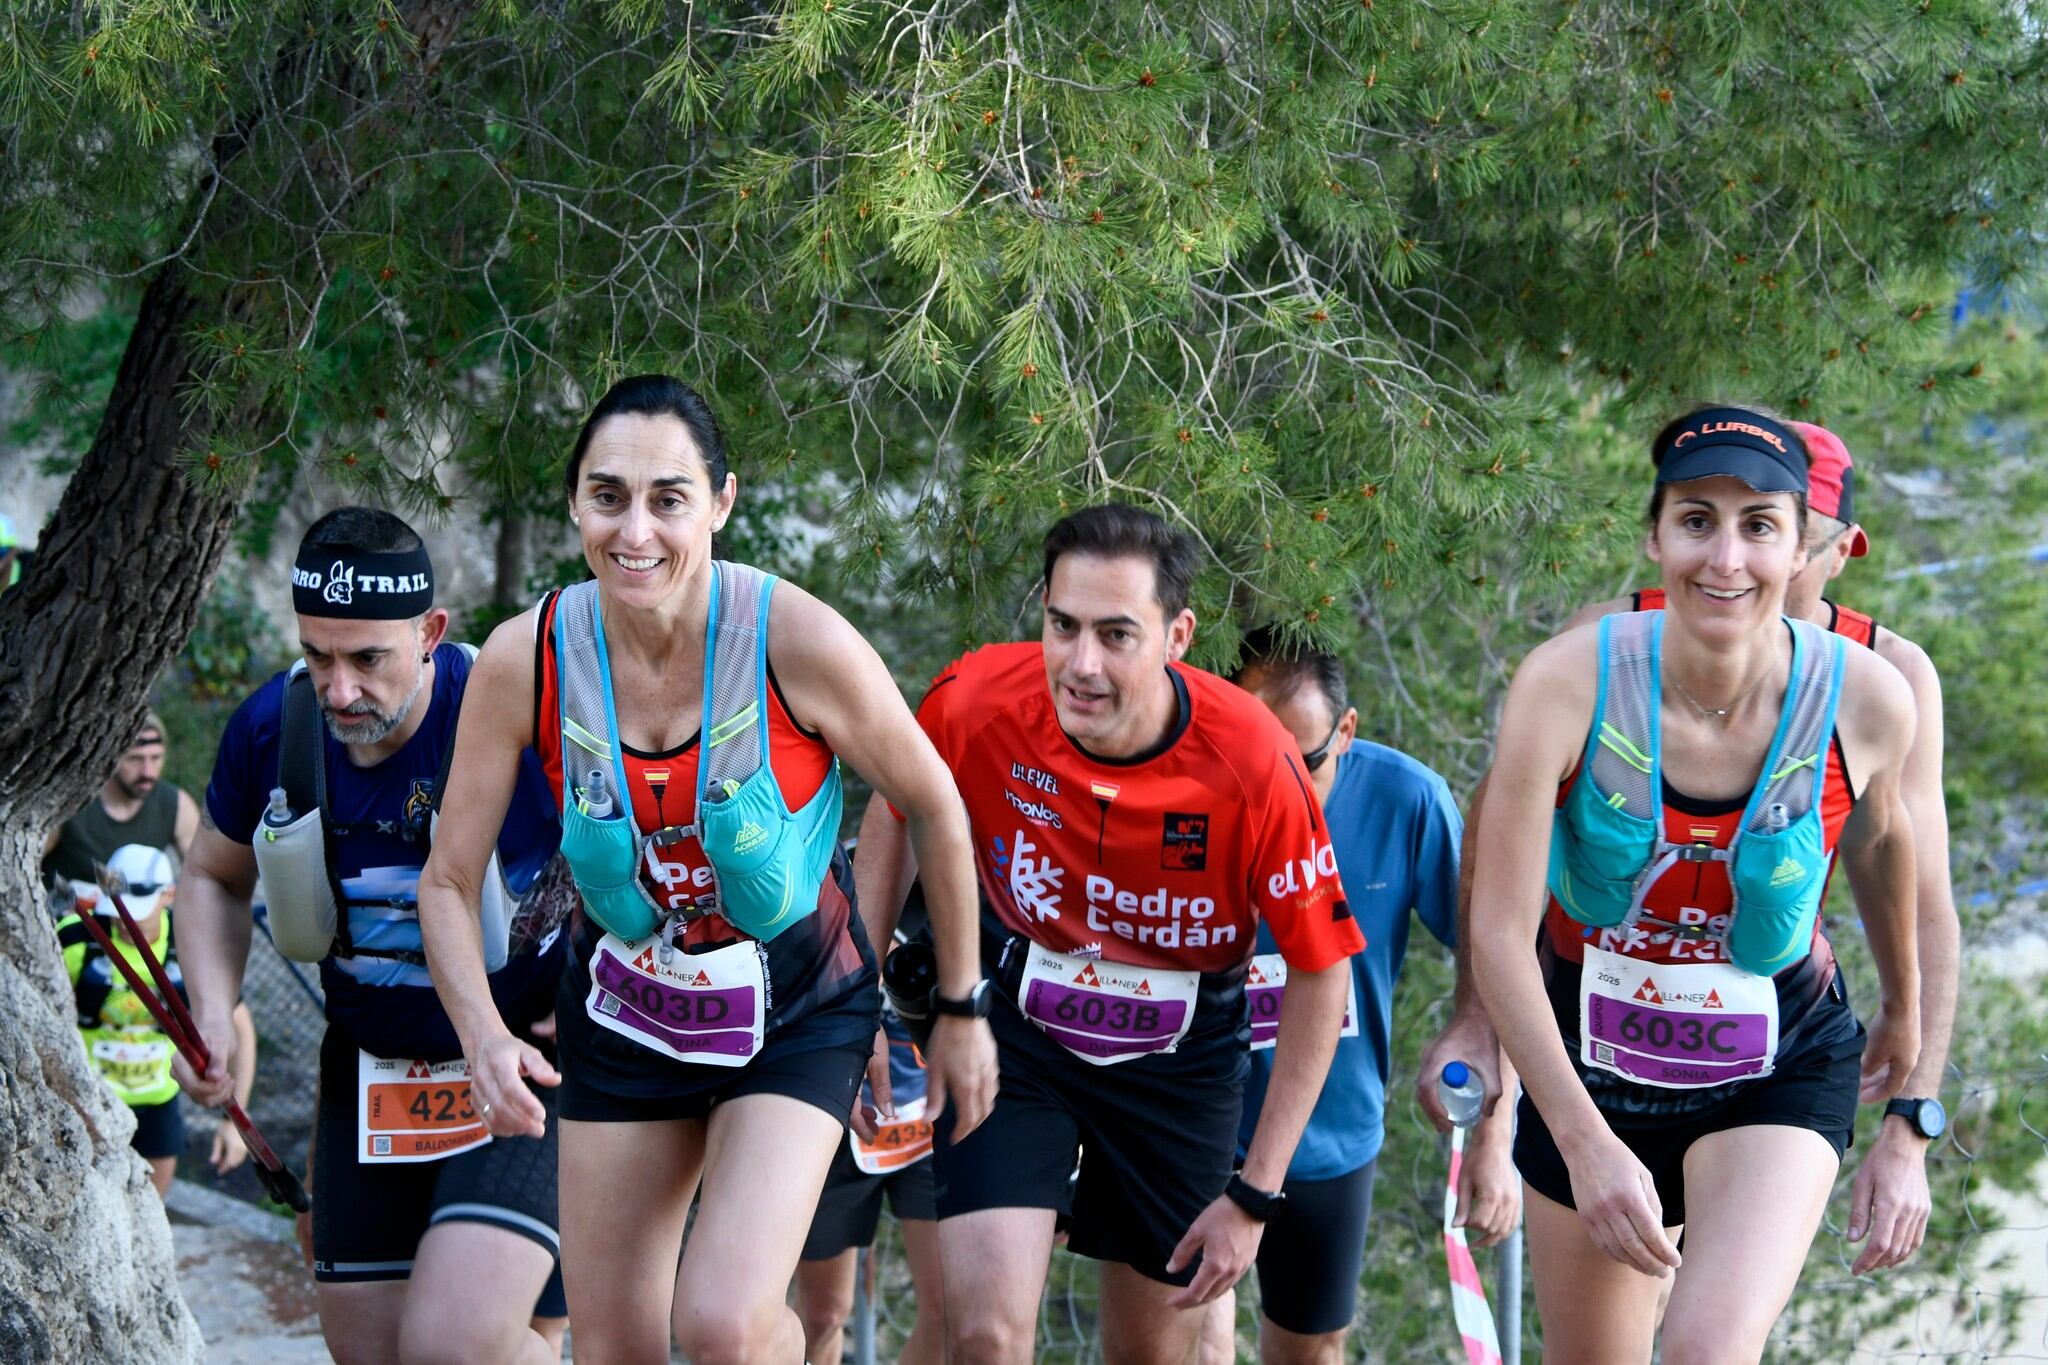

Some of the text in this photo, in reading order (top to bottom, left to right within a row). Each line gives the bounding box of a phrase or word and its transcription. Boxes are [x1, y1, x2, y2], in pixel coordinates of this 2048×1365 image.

[1701, 421, 1787, 453] LURBEL
[357, 572, 429, 594] TRAIL
[1268, 858, 1300, 899] el
[1085, 874, 1215, 920] Pedro
[1086, 904, 1237, 948] Cerdán
[1042, 958, 1063, 971] 2025
[1597, 972, 1621, 986] 2025
[618, 975, 729, 1024] 603D
[1055, 993, 1161, 1032] 603B
[1619, 1011, 1740, 1054] 603C
[374, 1061, 396, 1071] 2025
[1661, 1067, 1711, 1081] SONIA
[373, 1093, 382, 1118] TRAIL
[409, 1089, 476, 1122] 423
